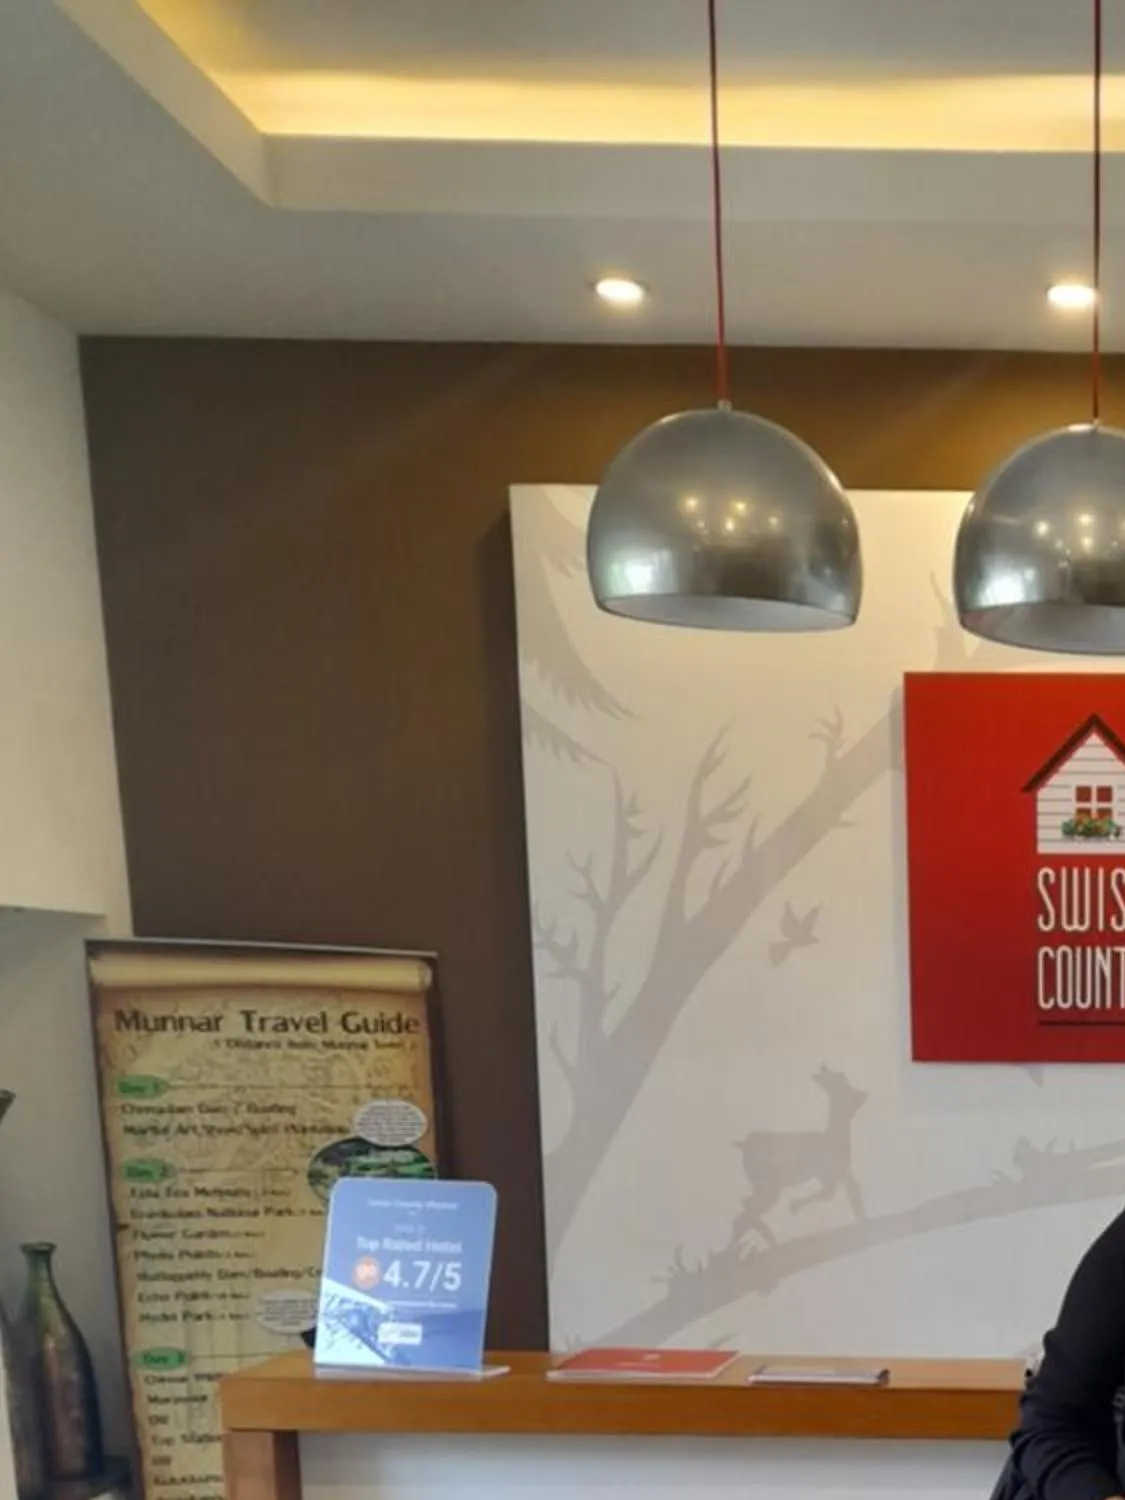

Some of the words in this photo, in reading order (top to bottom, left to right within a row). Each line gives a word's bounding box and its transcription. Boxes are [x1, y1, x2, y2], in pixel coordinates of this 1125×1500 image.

[114, 1009, 224, 1034] Munnar
[240, 1010, 328, 1033] Travel
[340, 1011, 420, 1034] Guide
[383, 1259, 463, 1292] 4.7/5
